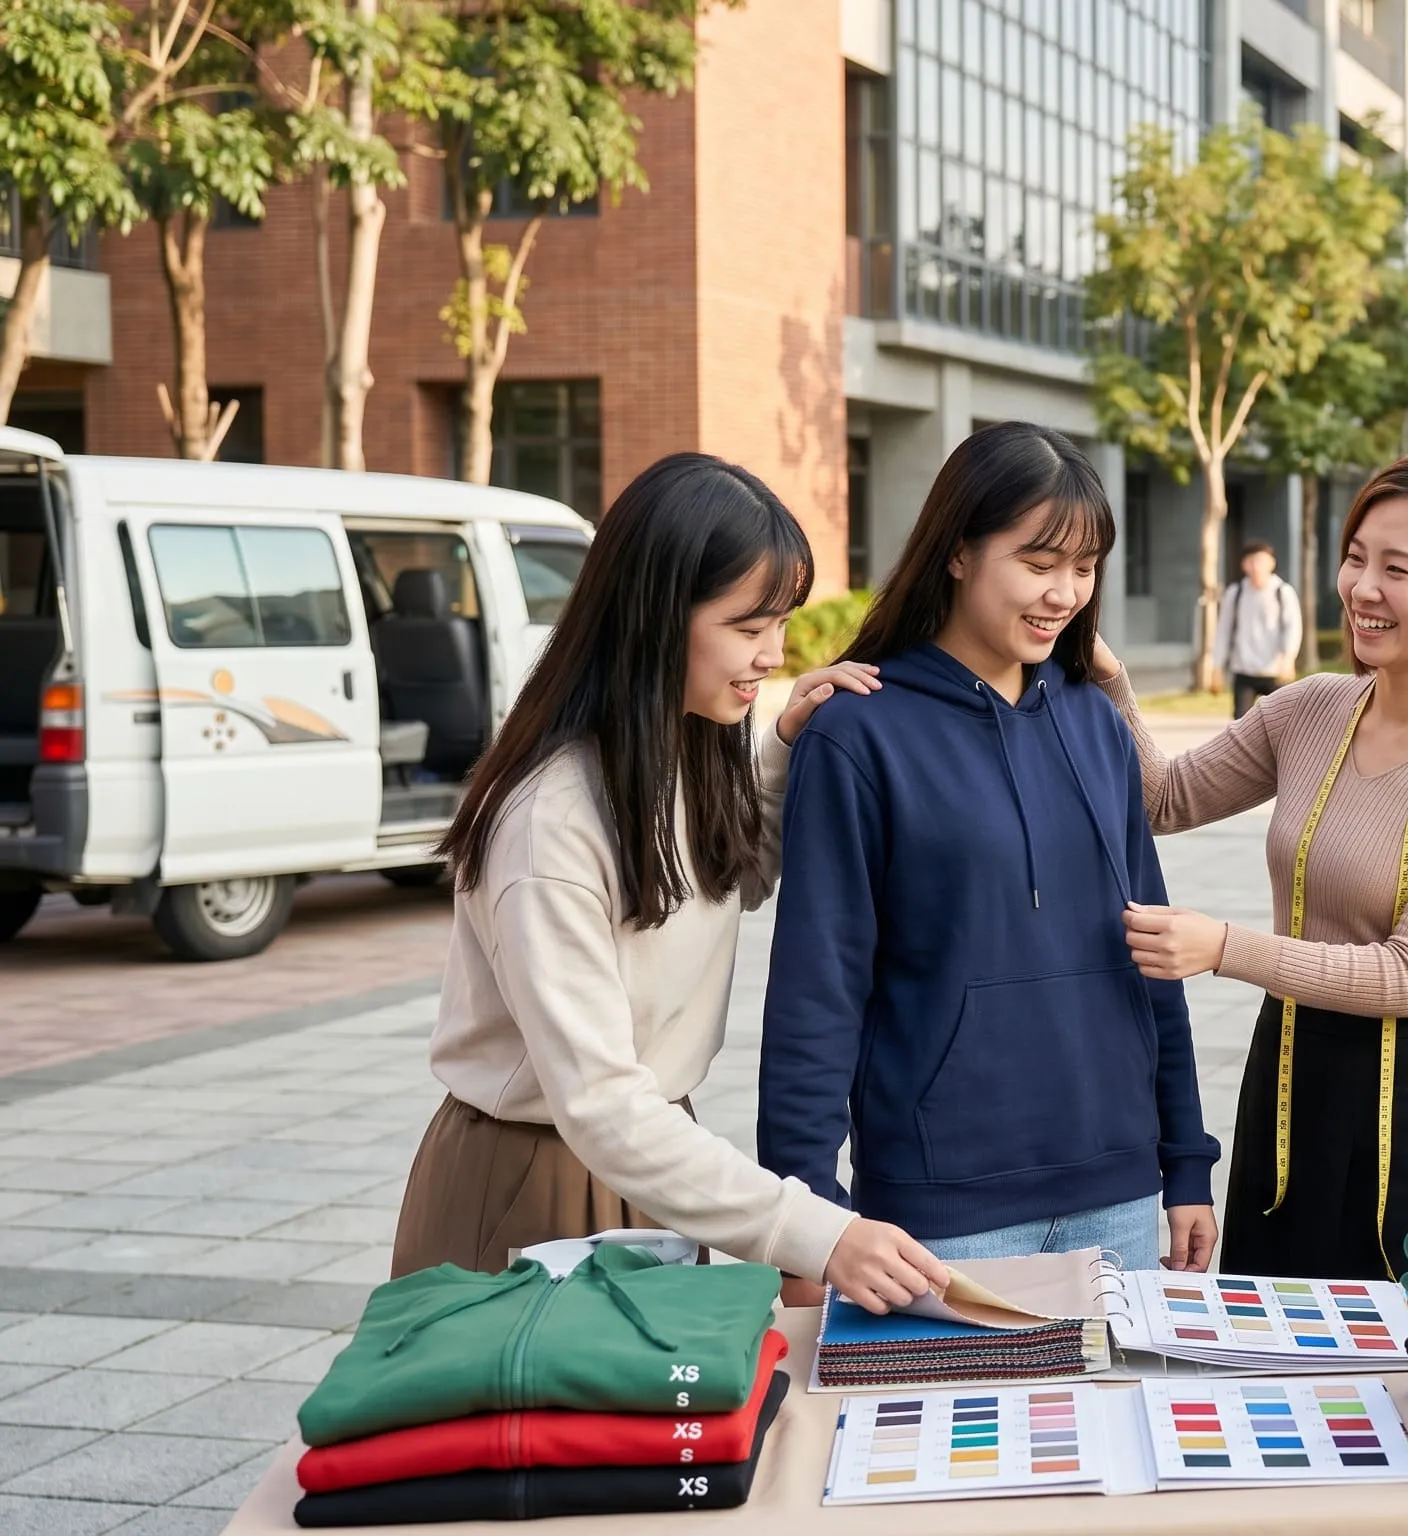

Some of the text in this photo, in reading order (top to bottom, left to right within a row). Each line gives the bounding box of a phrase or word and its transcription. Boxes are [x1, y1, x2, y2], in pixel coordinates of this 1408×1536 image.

[669, 1364, 700, 1383] XS
[676, 1392, 690, 1407] S
[672, 1422, 703, 1440] XS
[680, 1448, 694, 1462] S
[678, 1476, 709, 1496] XS
